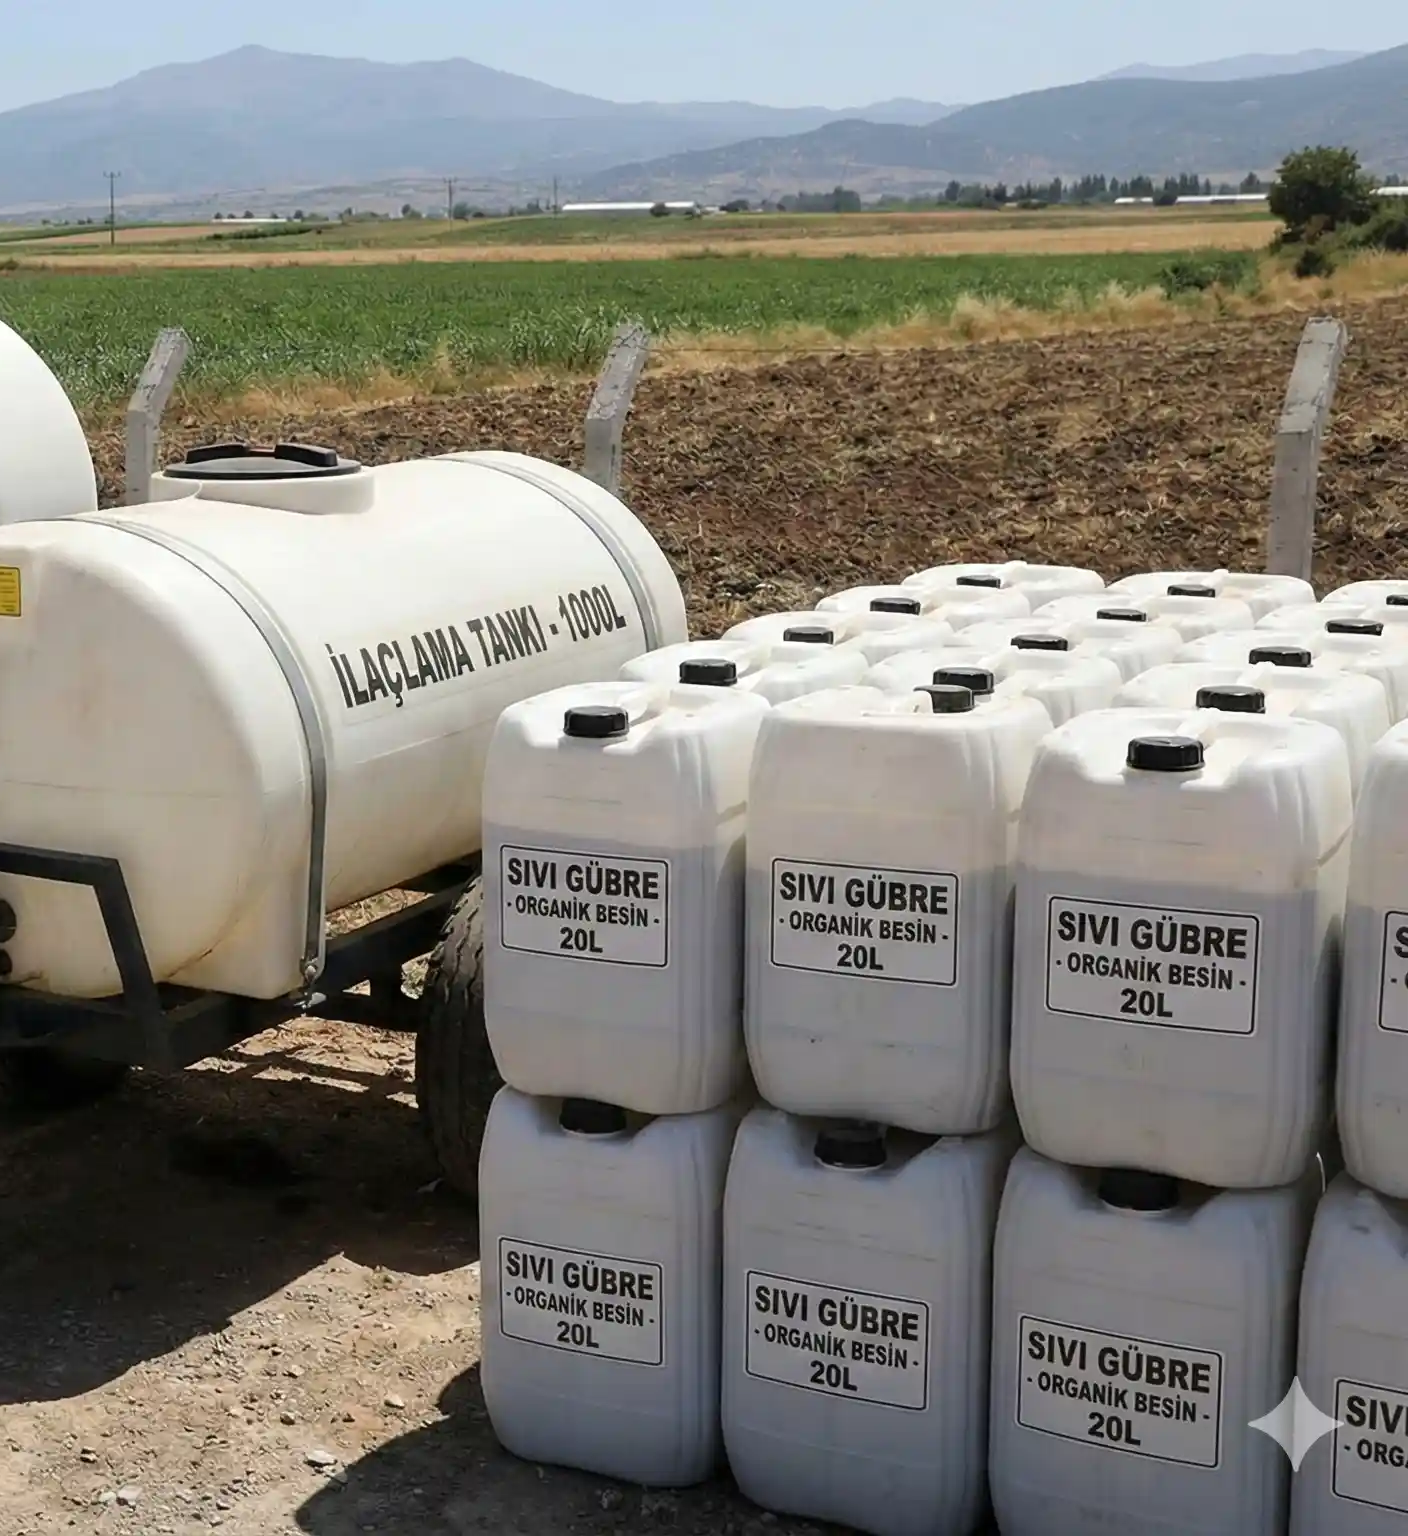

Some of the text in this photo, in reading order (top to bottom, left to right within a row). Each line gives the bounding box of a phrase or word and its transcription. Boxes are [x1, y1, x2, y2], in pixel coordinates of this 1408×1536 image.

[325, 626, 475, 708] İLAÇLAMA
[467, 605, 548, 667] TANKI
[558, 584, 626, 641] 1000L
[508, 858, 658, 899] SIVI GÜBRE
[780, 872, 948, 914] SIVI GÜBRE
[516, 895, 591, 921] ORGANİK
[597, 903, 648, 927] BESİN
[790, 911, 873, 938] ORGANİK
[880, 919, 936, 943] BESİN
[560, 927, 603, 953] 20L
[1058, 911, 1247, 959] SIVI GÜBRE
[837, 944, 883, 970] 20L
[1068, 952, 1161, 983] ORGANİK
[1169, 962, 1232, 990] BESİN
[1120, 988, 1172, 1017] 20L
[506, 1251, 653, 1300] SIVI GÜBRE
[515, 1287, 588, 1317] ORGANİK
[593, 1302, 643, 1326] BESİN
[755, 1286, 918, 1341] SIVI GÜBRE
[557, 1321, 599, 1348] 20L
[765, 1324, 845, 1358] ORGANİK
[852, 1341, 907, 1369] BESİN
[810, 1361, 857, 1391] 20L
[1028, 1331, 1210, 1393] SIVI GÜBRE
[1038, 1372, 1128, 1409] ORGANİK
[1135, 1393, 1196, 1422] BESİN
[1088, 1412, 1141, 1446] 20L
